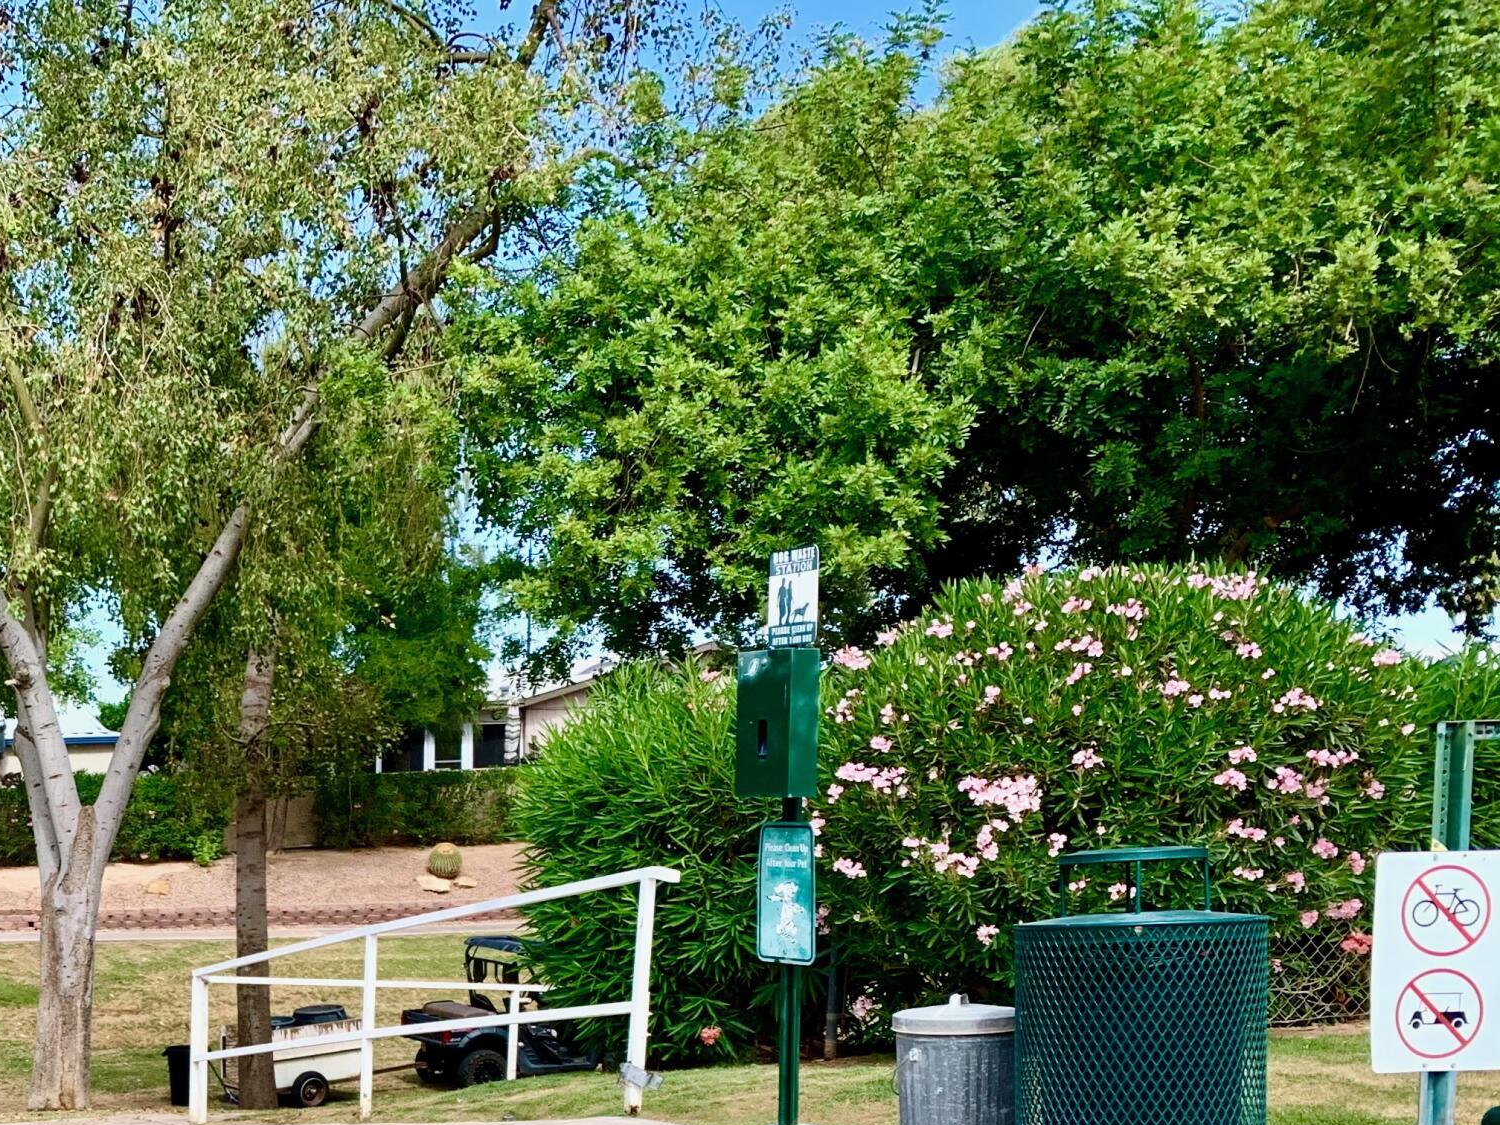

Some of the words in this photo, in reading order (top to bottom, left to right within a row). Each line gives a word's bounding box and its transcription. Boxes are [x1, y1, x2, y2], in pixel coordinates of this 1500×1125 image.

[791, 547, 815, 561] WASTE
[775, 560, 812, 575] STATION
[799, 843, 809, 856] Up
[765, 858, 782, 868] After
